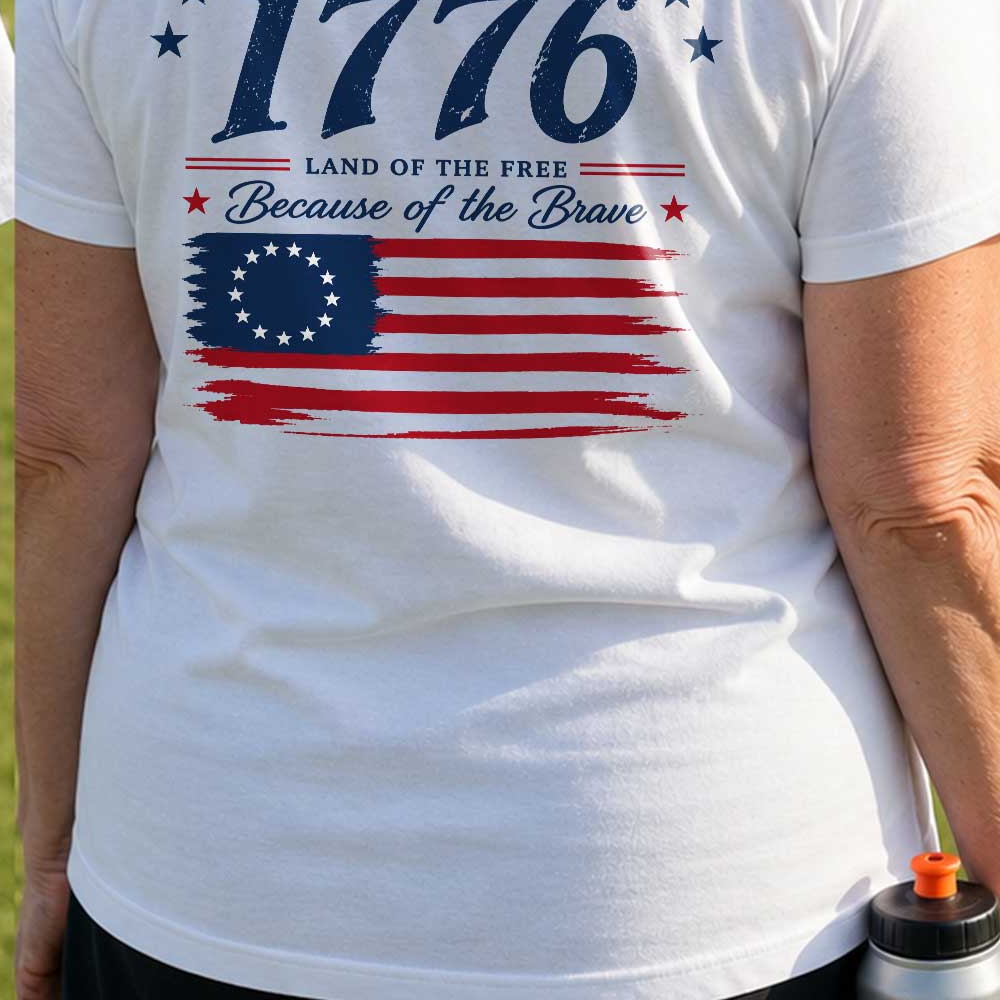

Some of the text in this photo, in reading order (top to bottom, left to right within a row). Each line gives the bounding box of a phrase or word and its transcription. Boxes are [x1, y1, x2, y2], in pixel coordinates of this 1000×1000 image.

[304, 157, 569, 179] LAND OF THE FREE
[224, 179, 648, 233] Because of the Brave
